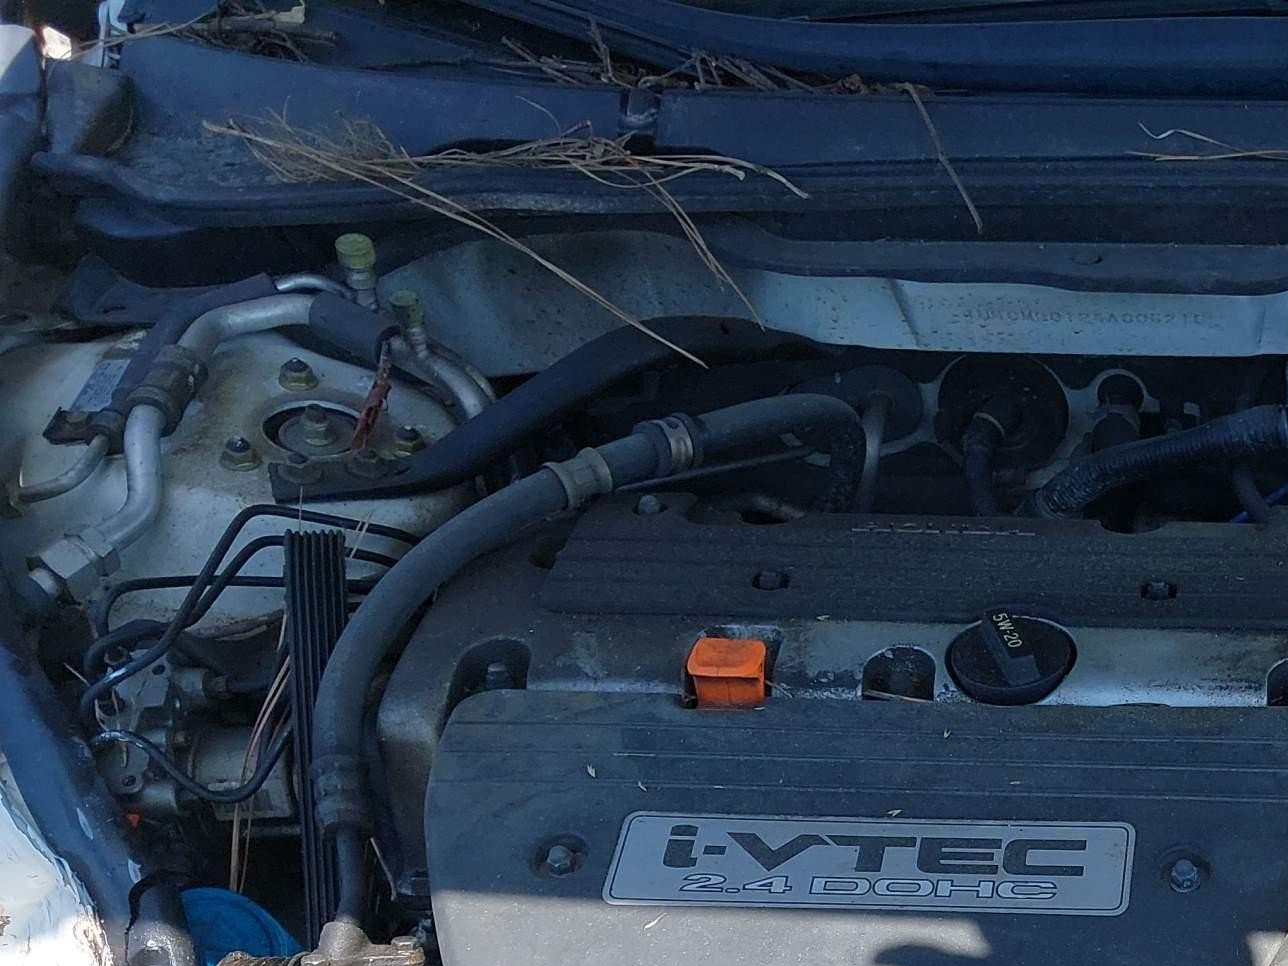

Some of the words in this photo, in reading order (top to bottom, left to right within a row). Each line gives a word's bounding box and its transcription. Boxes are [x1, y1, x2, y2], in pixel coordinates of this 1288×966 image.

[993, 613, 1022, 648] 5W-20
[663, 824, 1087, 876] i-VTEC
[680, 873, 792, 894] 2.4
[809, 877, 1058, 899] DOHC
